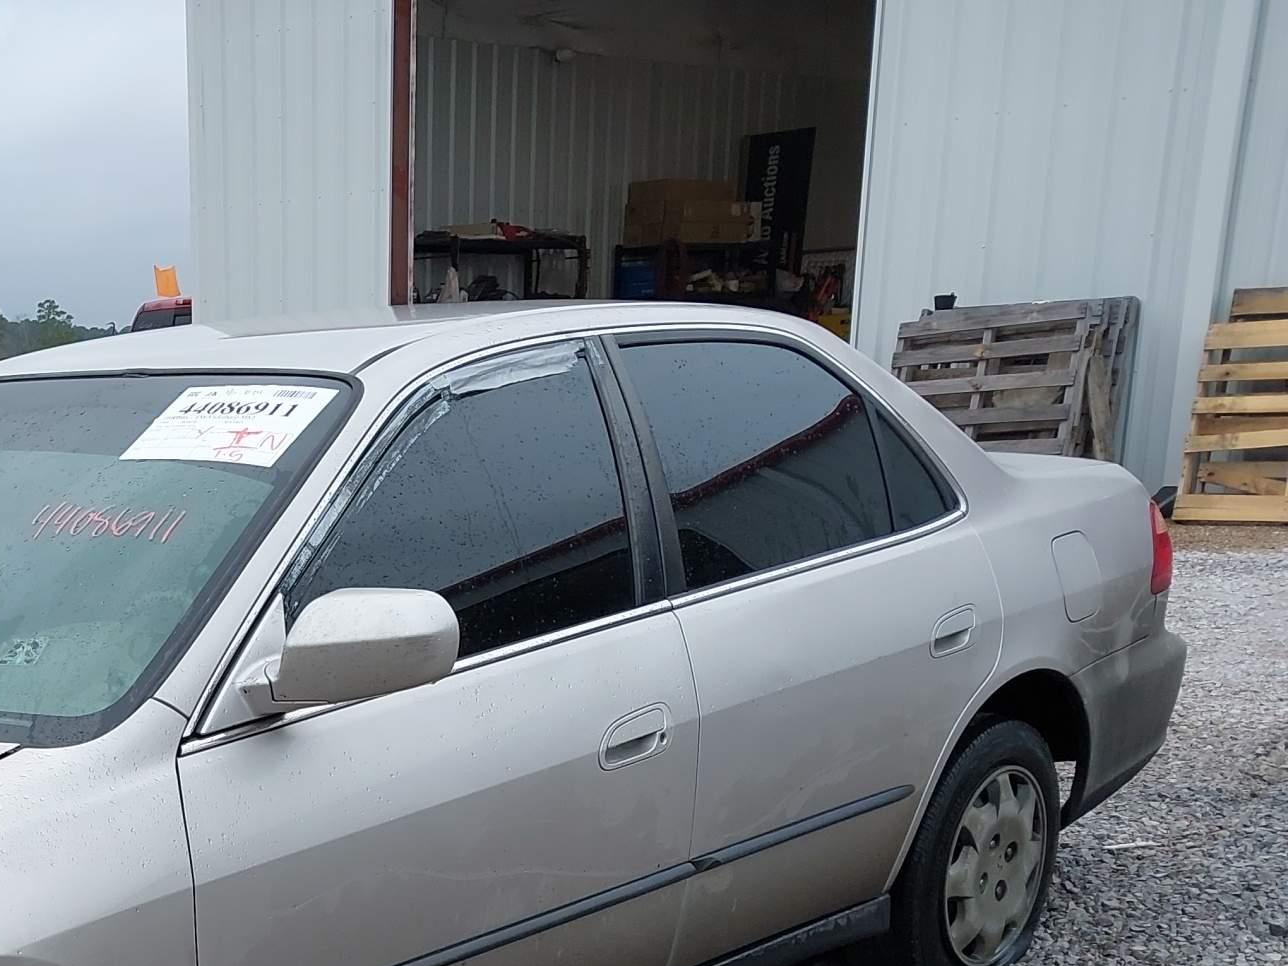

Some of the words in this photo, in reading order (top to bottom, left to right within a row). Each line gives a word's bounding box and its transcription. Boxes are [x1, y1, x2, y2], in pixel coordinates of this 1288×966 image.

[761, 144, 781, 221] Auctions
[179, 401, 299, 418] 44086911
[32, 501, 187, 544] 44086911
